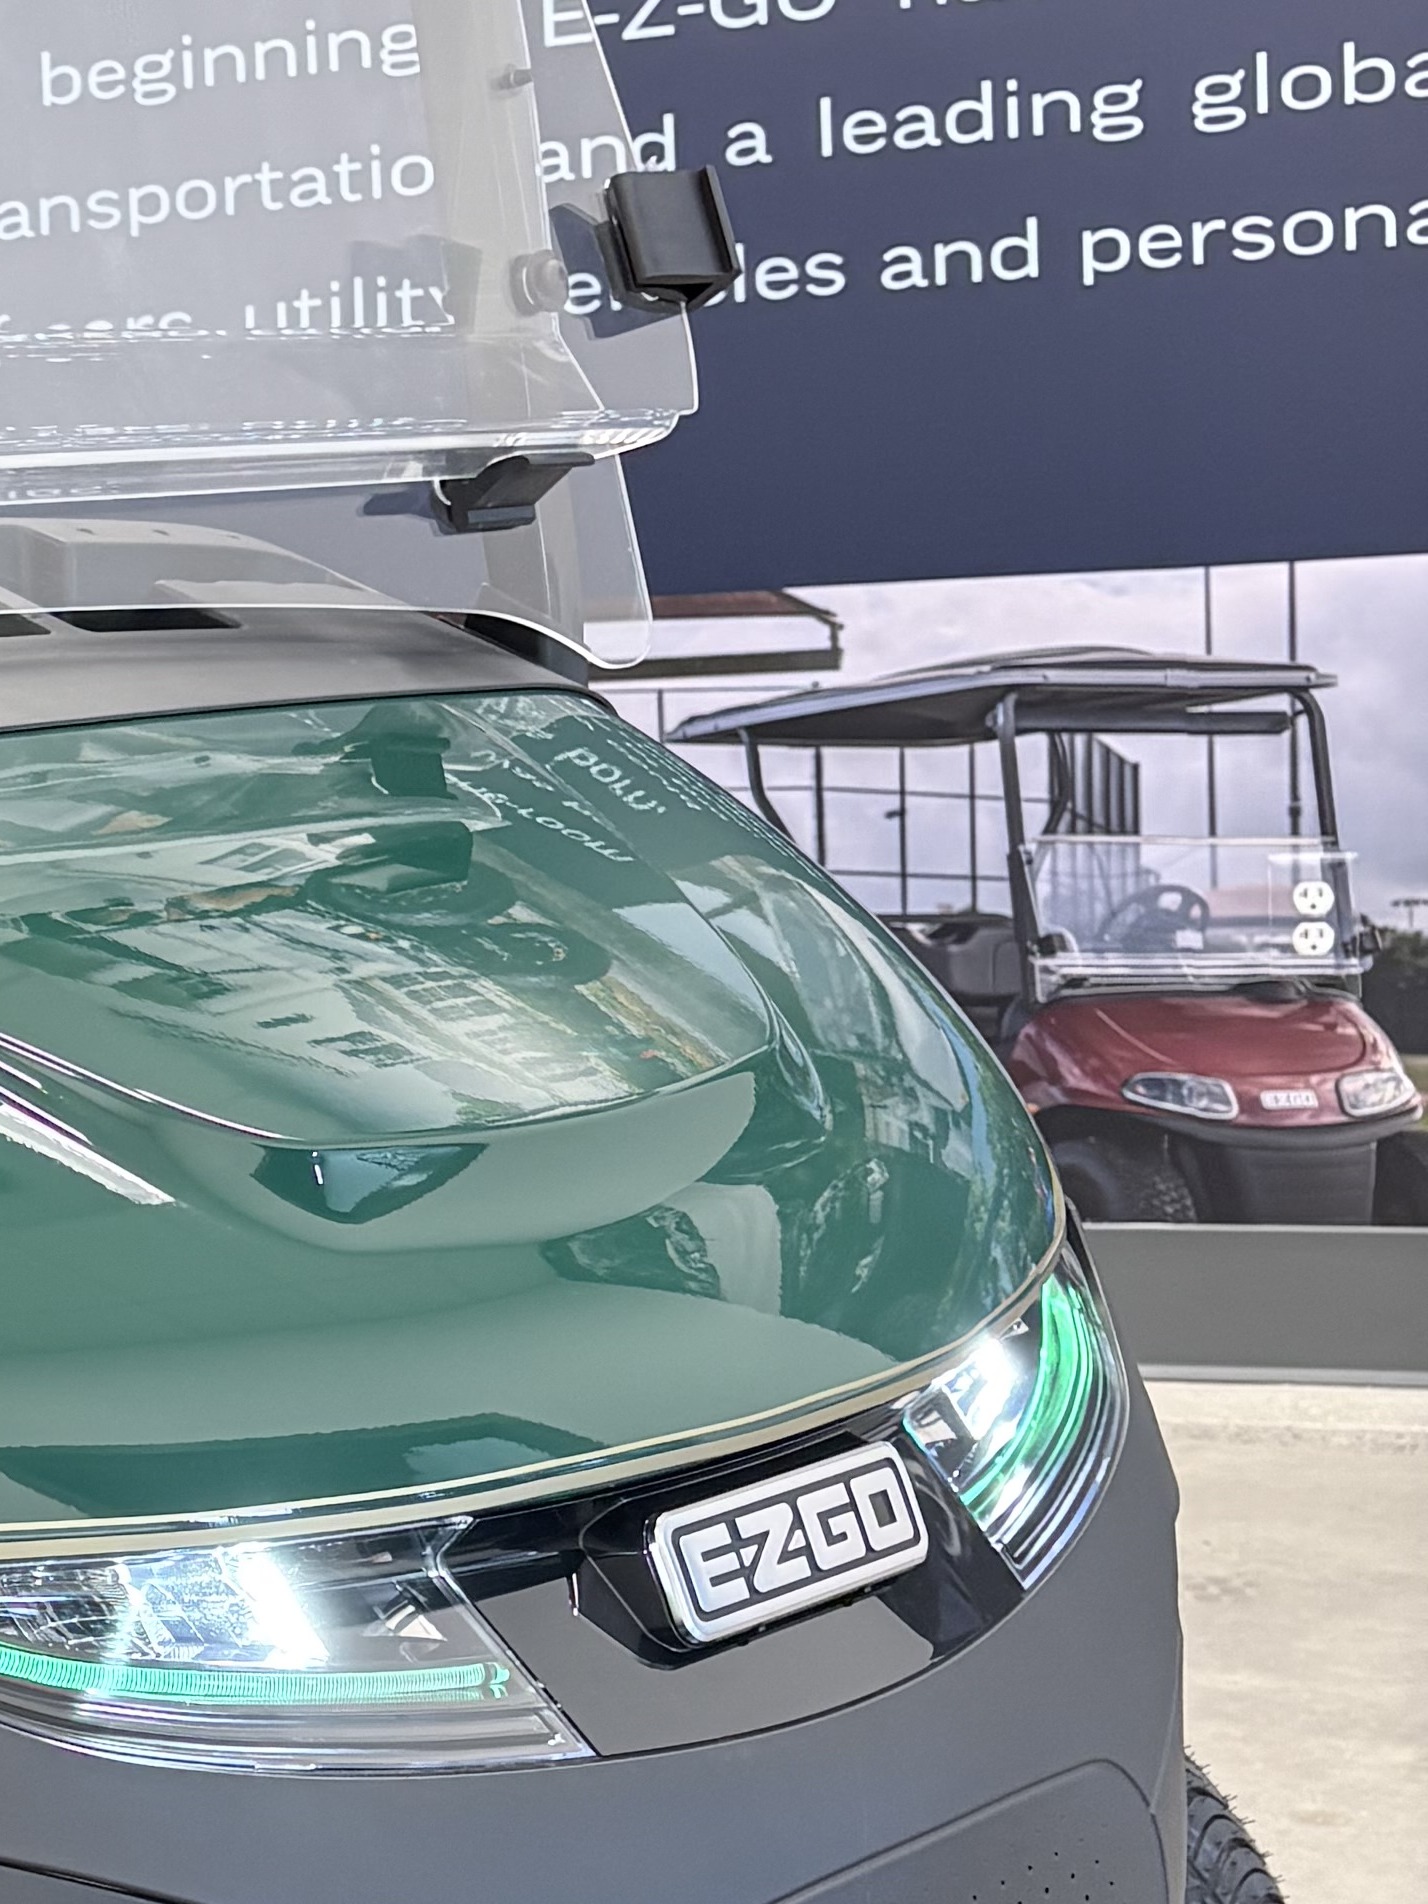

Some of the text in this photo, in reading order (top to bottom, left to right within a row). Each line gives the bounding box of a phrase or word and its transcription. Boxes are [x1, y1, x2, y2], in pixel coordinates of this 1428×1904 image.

[40, 18, 421, 108] beginning
[535, 112, 676, 184] and
[724, 118, 774, 167] a
[819, 77, 1145, 158] leading
[879, 215, 1040, 290] and
